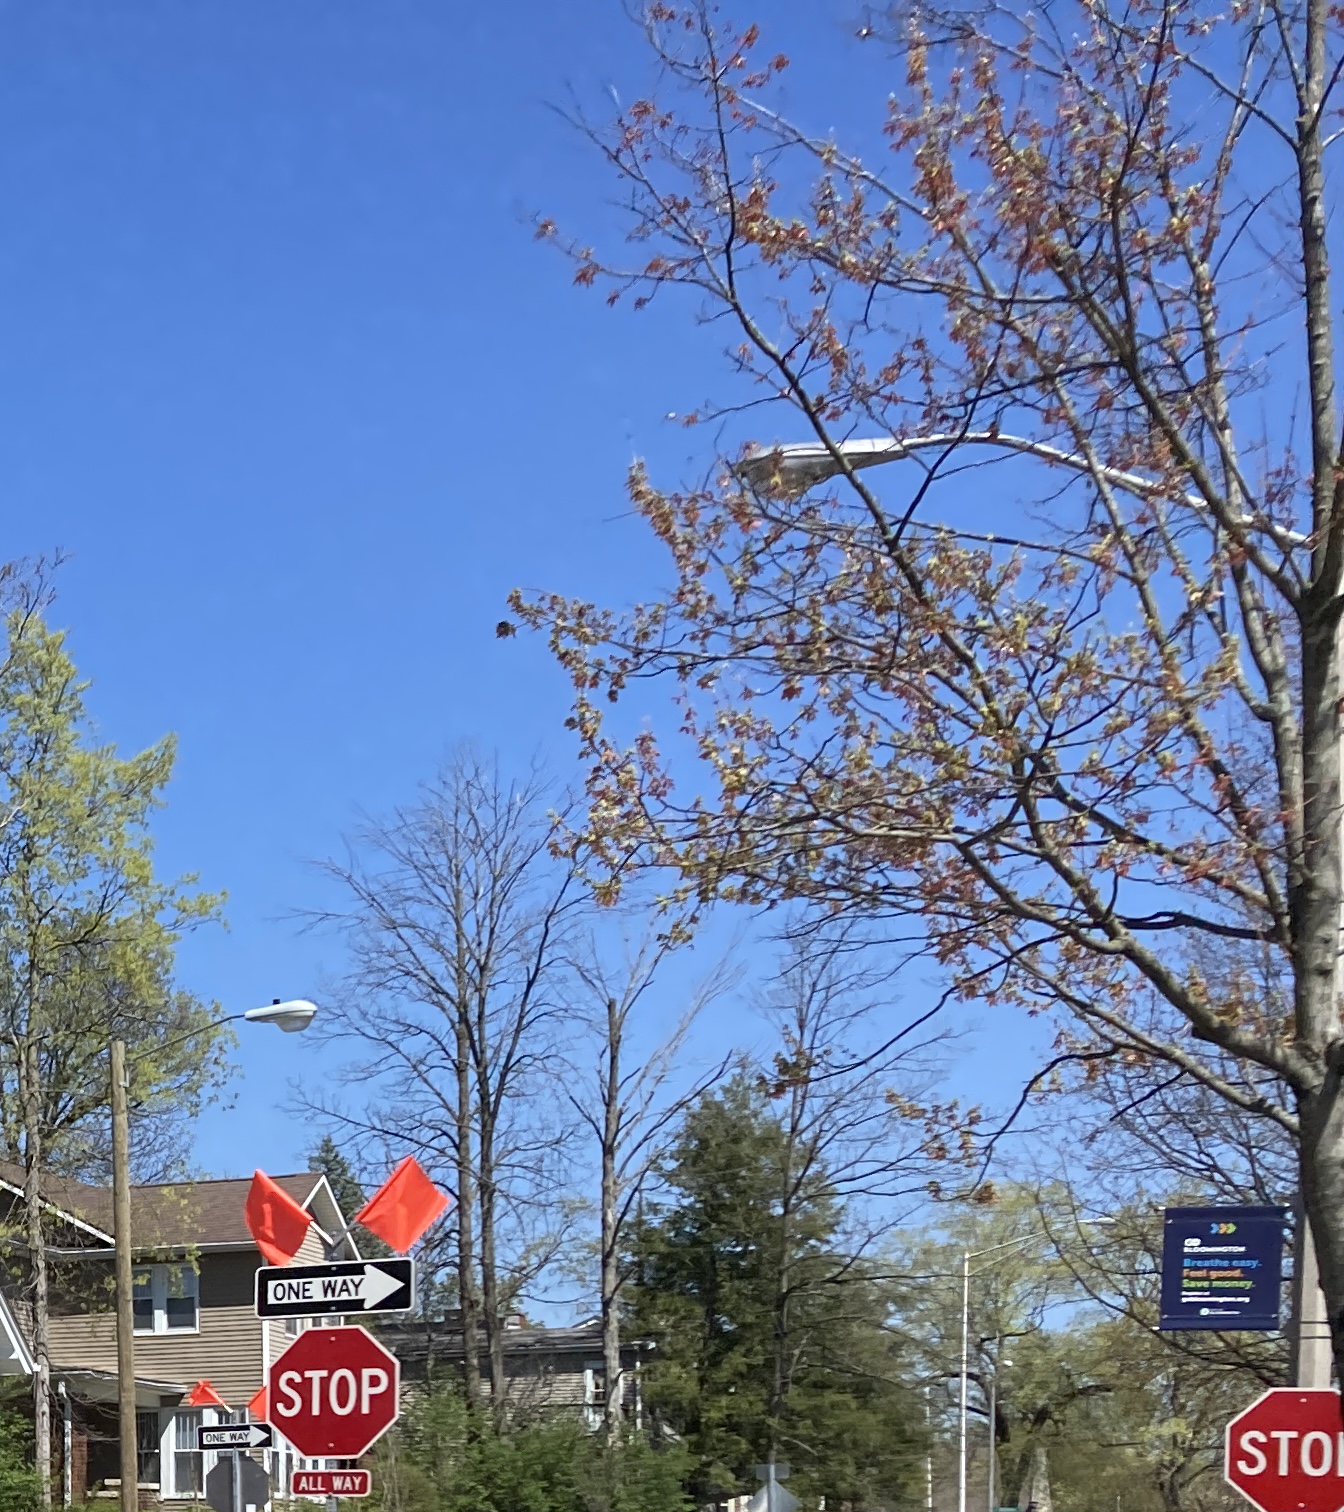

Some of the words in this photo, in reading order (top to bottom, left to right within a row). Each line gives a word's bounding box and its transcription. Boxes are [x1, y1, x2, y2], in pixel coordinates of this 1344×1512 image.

[1183, 1258, 1230, 1267] Breathe
[1232, 1259, 1262, 1269] easy.
[1183, 1269, 1207, 1278] Feel
[1209, 1269, 1244, 1280] good.
[273, 1281, 314, 1301] ONE
[321, 1277, 365, 1298] WAY
[1182, 1279, 1210, 1288] Save
[1212, 1280, 1256, 1290] money.
[276, 1368, 389, 1418] STOP
[205, 1432, 226, 1443] ONE
[229, 1432, 249, 1442] WAY
[298, 1475, 326, 1491] ALL
[332, 1475, 362, 1491] WAY
